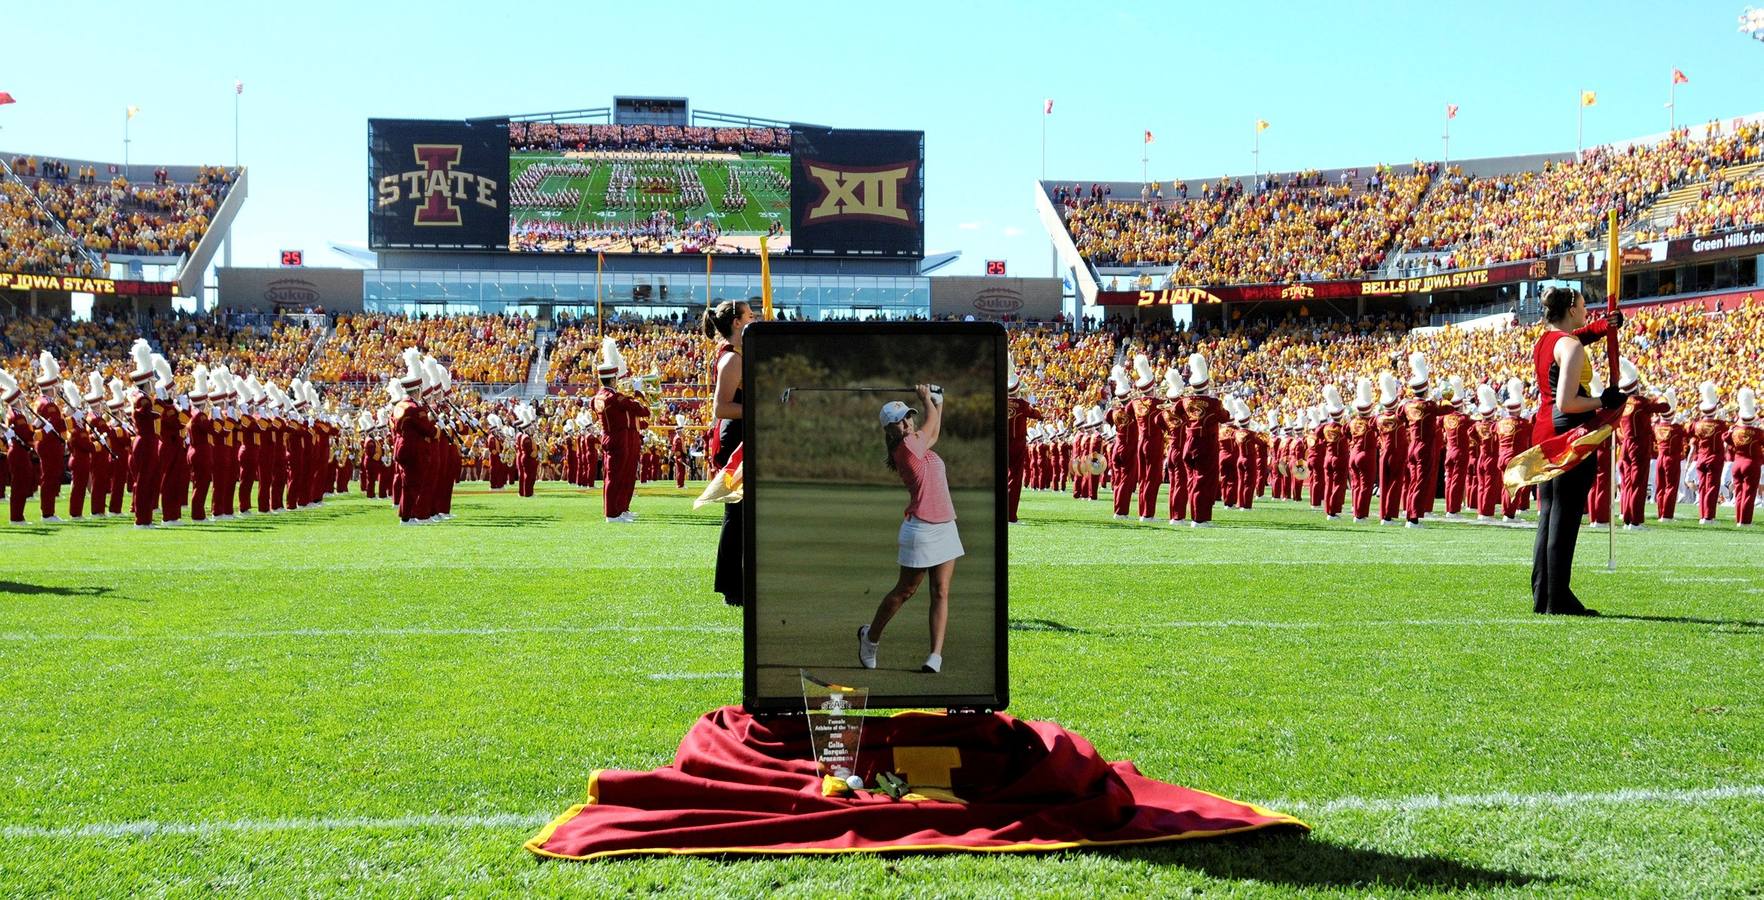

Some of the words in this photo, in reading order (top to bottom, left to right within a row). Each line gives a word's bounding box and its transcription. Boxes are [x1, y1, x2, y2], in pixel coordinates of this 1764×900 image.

[378, 170, 497, 208] STATE
[809, 165, 909, 221] XII
[1692, 238, 1724, 252] Green
[1725, 232, 1749, 248] Hills
[283, 251, 301, 265] 25
[988, 262, 1005, 274] 25
[10, 274, 60, 290] IOWA
[63, 277, 115, 293] STATE
[1361, 280, 1407, 294] BELLS
[1408, 279, 1421, 291] OF
[1419, 275, 1451, 293] IOWA
[1452, 269, 1488, 287] STATE
[1281, 287, 1314, 299] STATE
